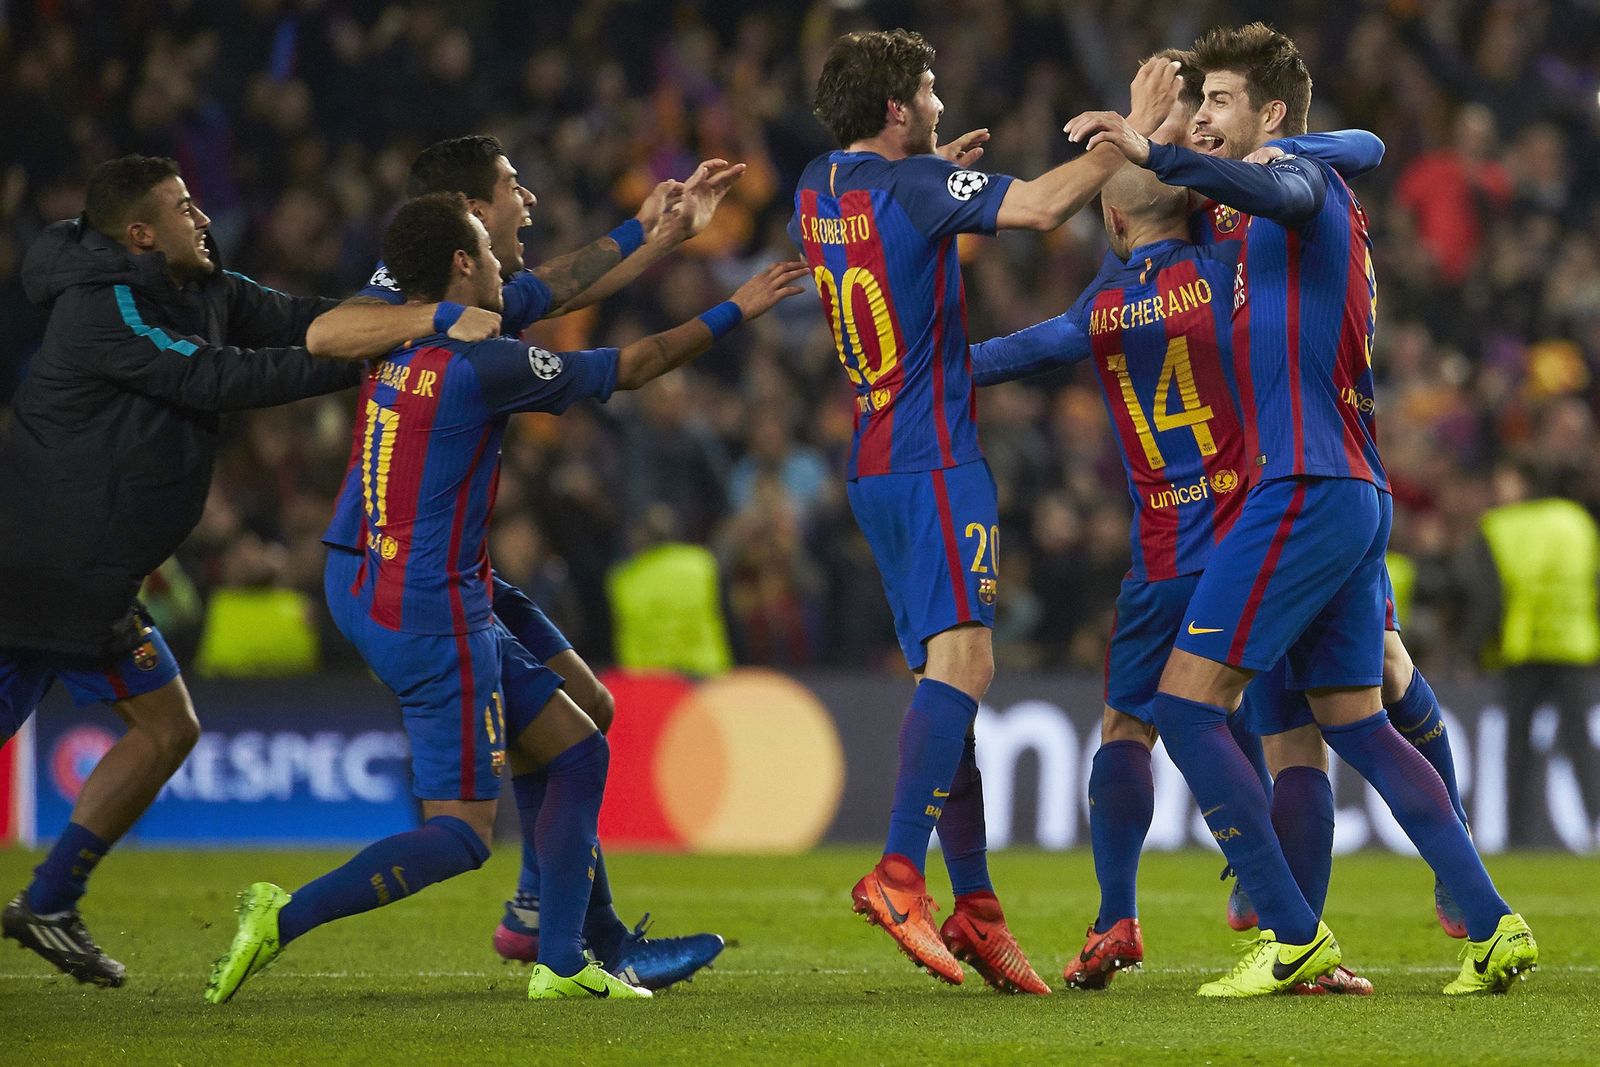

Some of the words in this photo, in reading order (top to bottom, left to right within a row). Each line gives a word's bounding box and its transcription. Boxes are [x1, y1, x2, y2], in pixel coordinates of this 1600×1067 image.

[801, 213, 811, 241] S.
[811, 213, 870, 245] ROBERTO
[814, 265, 898, 385] 20
[1088, 278, 1213, 336] MASCHERANO
[412, 369, 437, 397] JR
[1107, 335, 1218, 470] 14
[362, 398, 400, 526] 11
[1150, 476, 1209, 510] unicef
[965, 522, 1000, 577] 20
